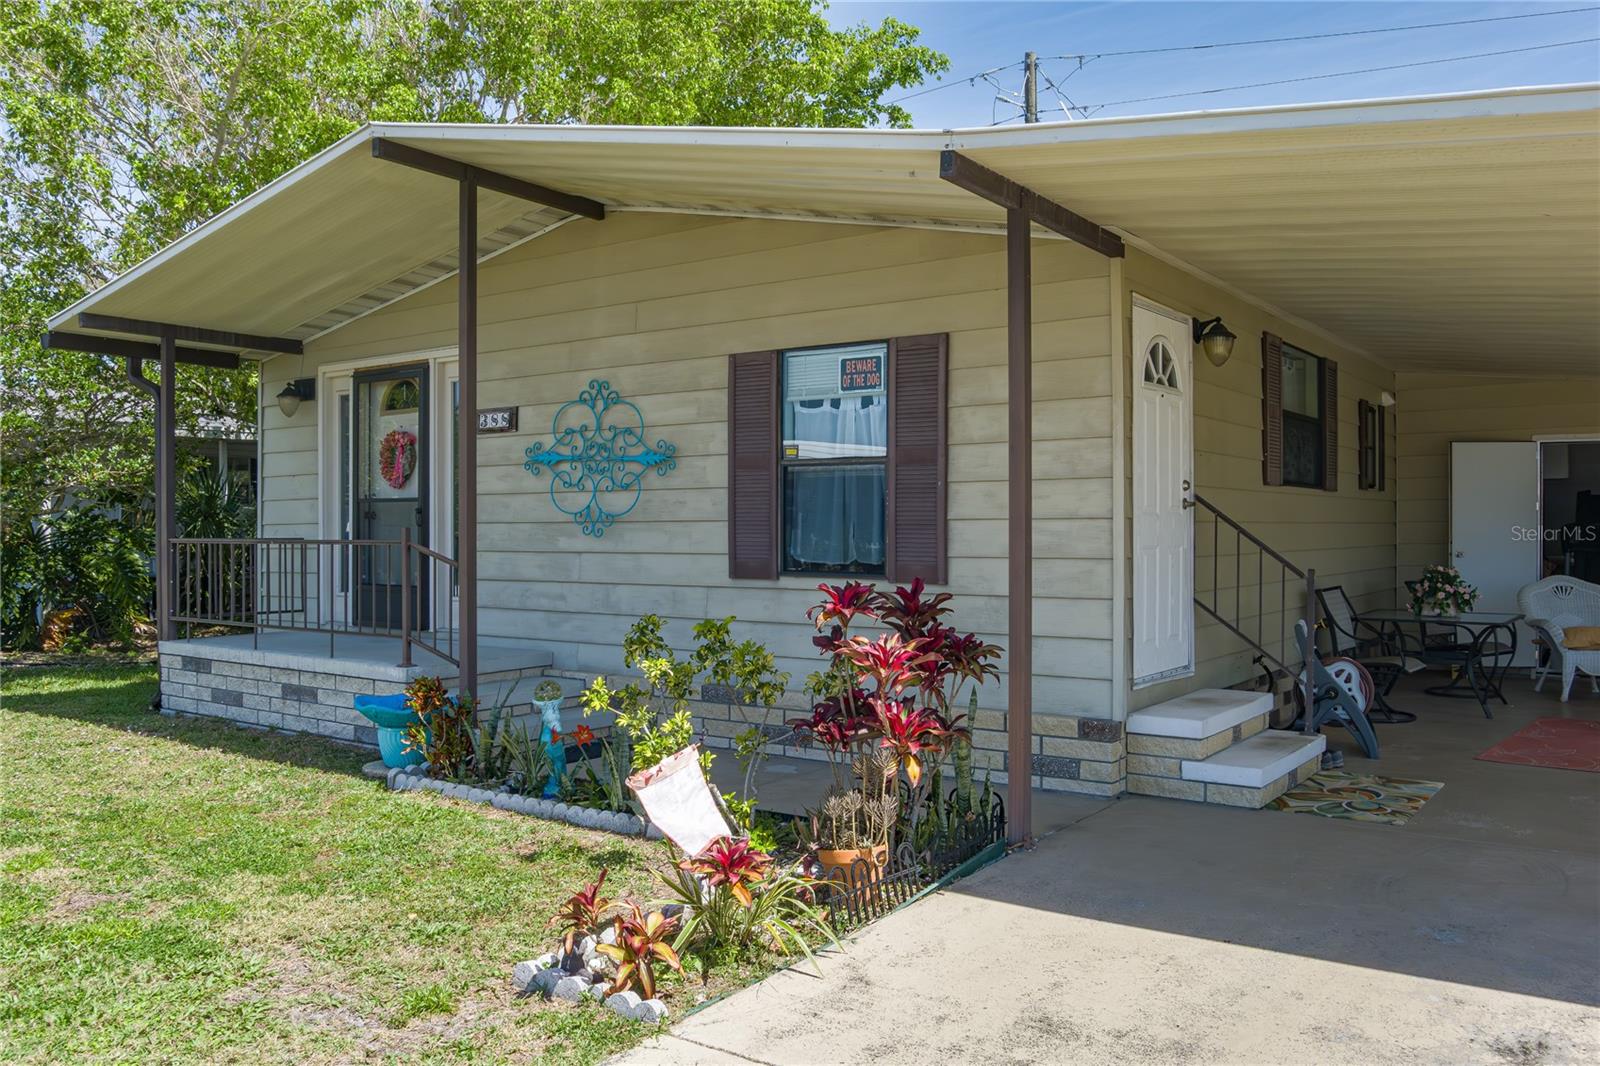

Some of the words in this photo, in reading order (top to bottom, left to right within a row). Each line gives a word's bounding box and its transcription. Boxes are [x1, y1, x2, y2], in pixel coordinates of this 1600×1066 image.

[845, 359, 877, 373] BEWARE
[842, 375, 851, 388] OF
[852, 374, 865, 387] THE
[866, 372, 880, 386] DOG
